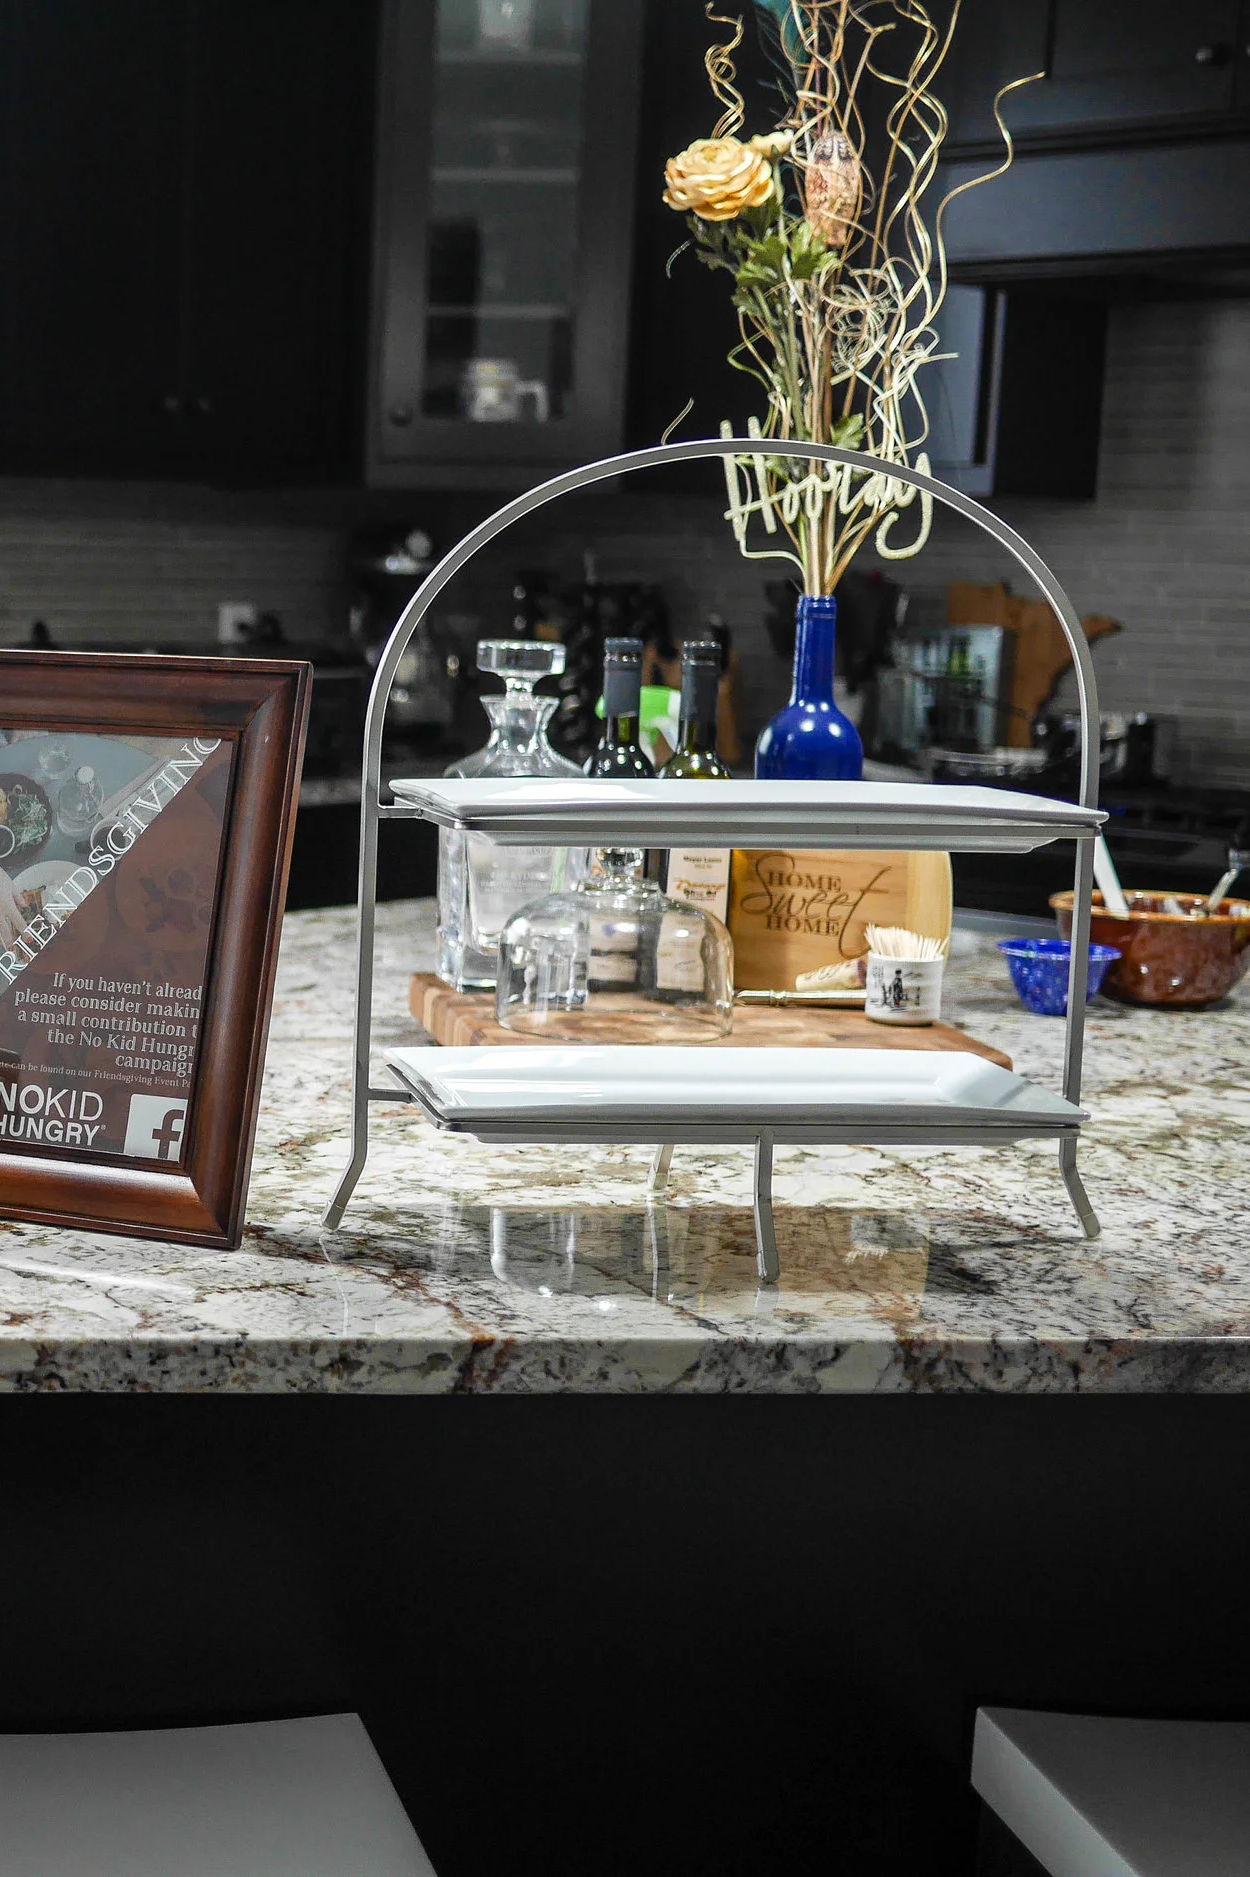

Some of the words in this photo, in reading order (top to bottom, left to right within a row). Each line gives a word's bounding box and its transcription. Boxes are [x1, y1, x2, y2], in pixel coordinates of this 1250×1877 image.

[767, 869, 842, 893] HOME
[740, 852, 892, 960] Sweet
[766, 914, 840, 937] HOME
[53, 972, 67, 988] If
[67, 977, 94, 993] you
[97, 976, 152, 996] haven't
[15, 988, 67, 1007] please
[71, 995, 143, 1014] consider
[17, 1008, 28, 1022] a
[31, 1008, 77, 1027] small
[81, 1014, 187, 1037] contribution
[47, 1028, 75, 1046] the
[78, 1030, 102, 1048] No
[106, 1033, 136, 1052] Kid
[28, 1062, 39, 1072] be
[39, 1064, 64, 1075] found
[65, 1068, 76, 1077] on
[78, 1070, 91, 1078] our
[94, 1069, 152, 1087] Friendsgiving
[154, 1076, 179, 1087] Event
